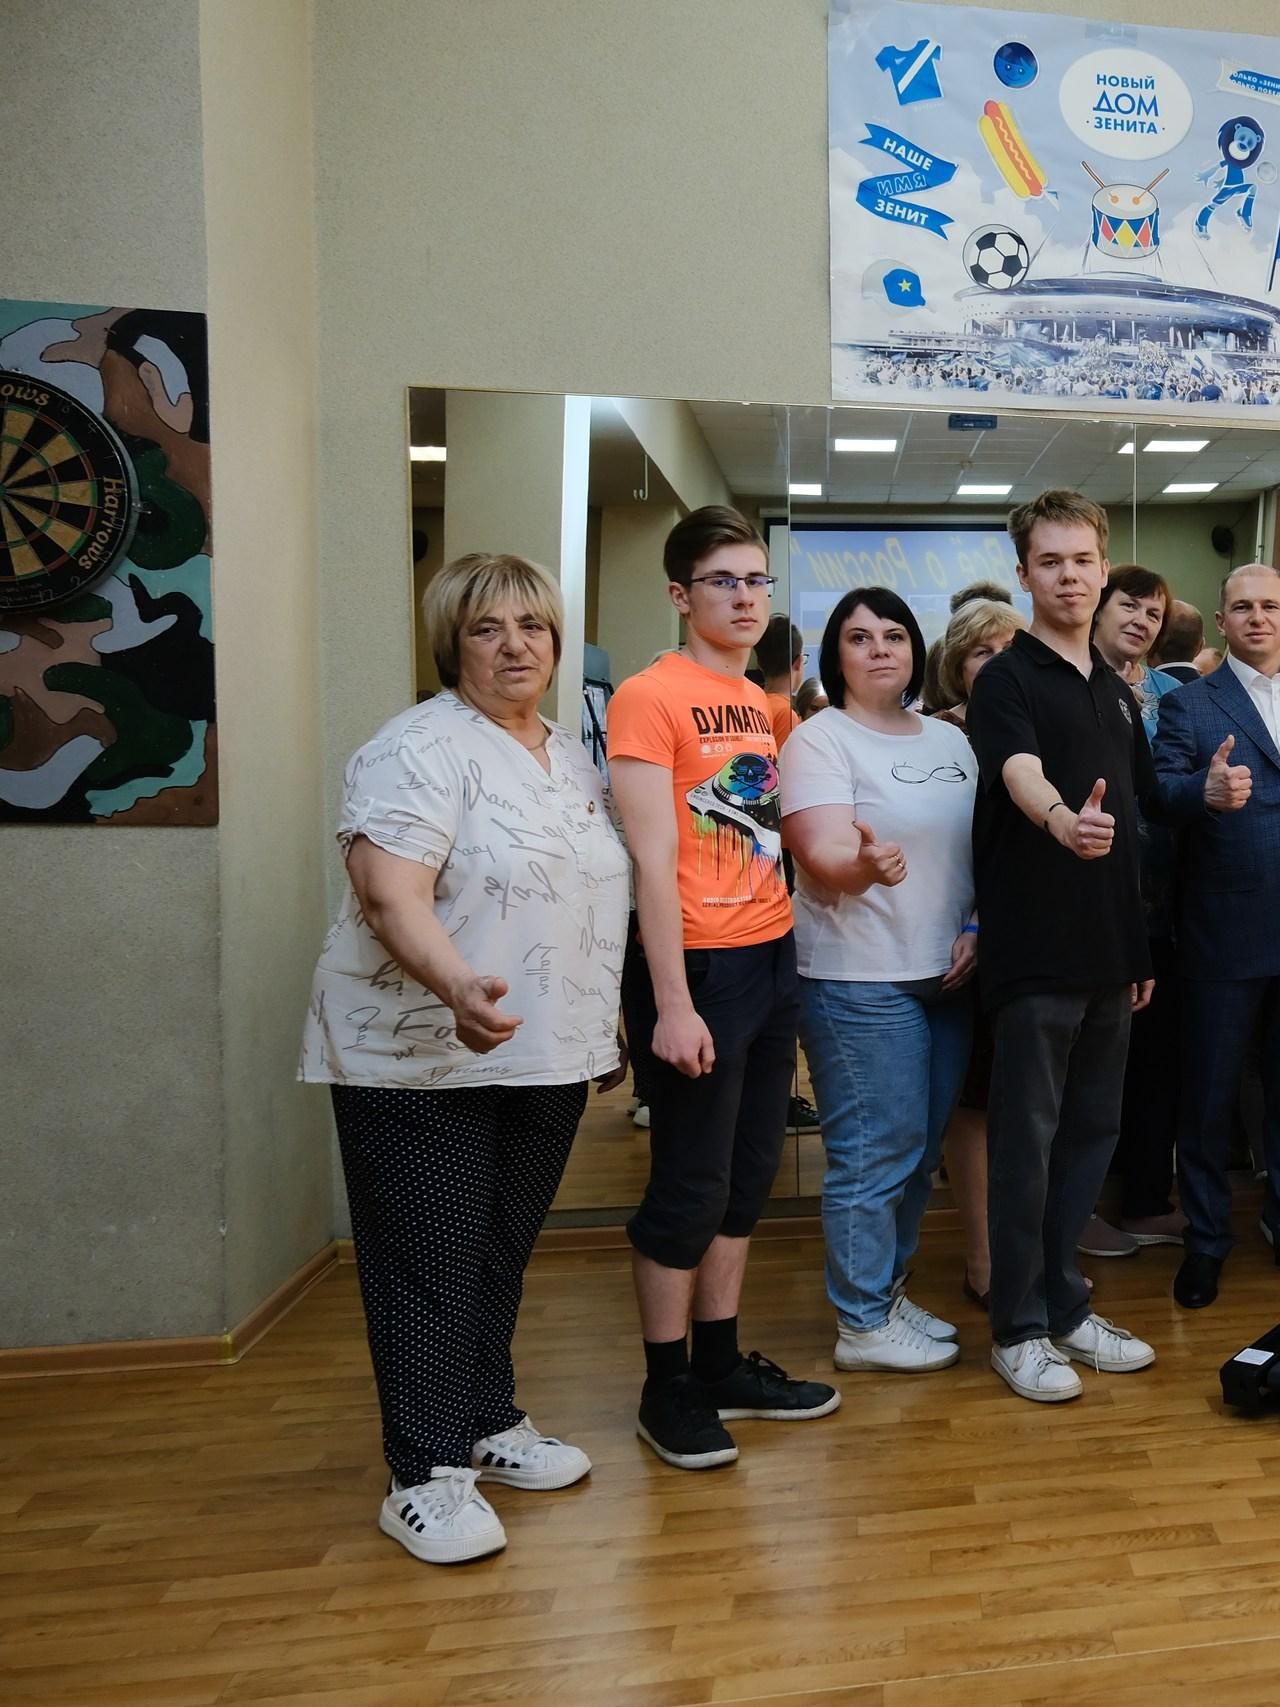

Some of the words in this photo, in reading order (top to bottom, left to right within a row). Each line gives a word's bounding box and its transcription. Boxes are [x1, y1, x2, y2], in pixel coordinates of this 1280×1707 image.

[1096, 74, 1155, 90] НОВЫЙ
[1232, 71, 1258, 84] ОЛЬКО
[1092, 90, 1159, 117] ДОМ
[1094, 116, 1158, 134] ЗЕНИТА
[883, 137, 933, 171] НАШЕ
[877, 172, 927, 197] ИМЯ
[874, 199, 929, 225] ЗЕНИТ
[77, 475, 125, 571] Harrows
